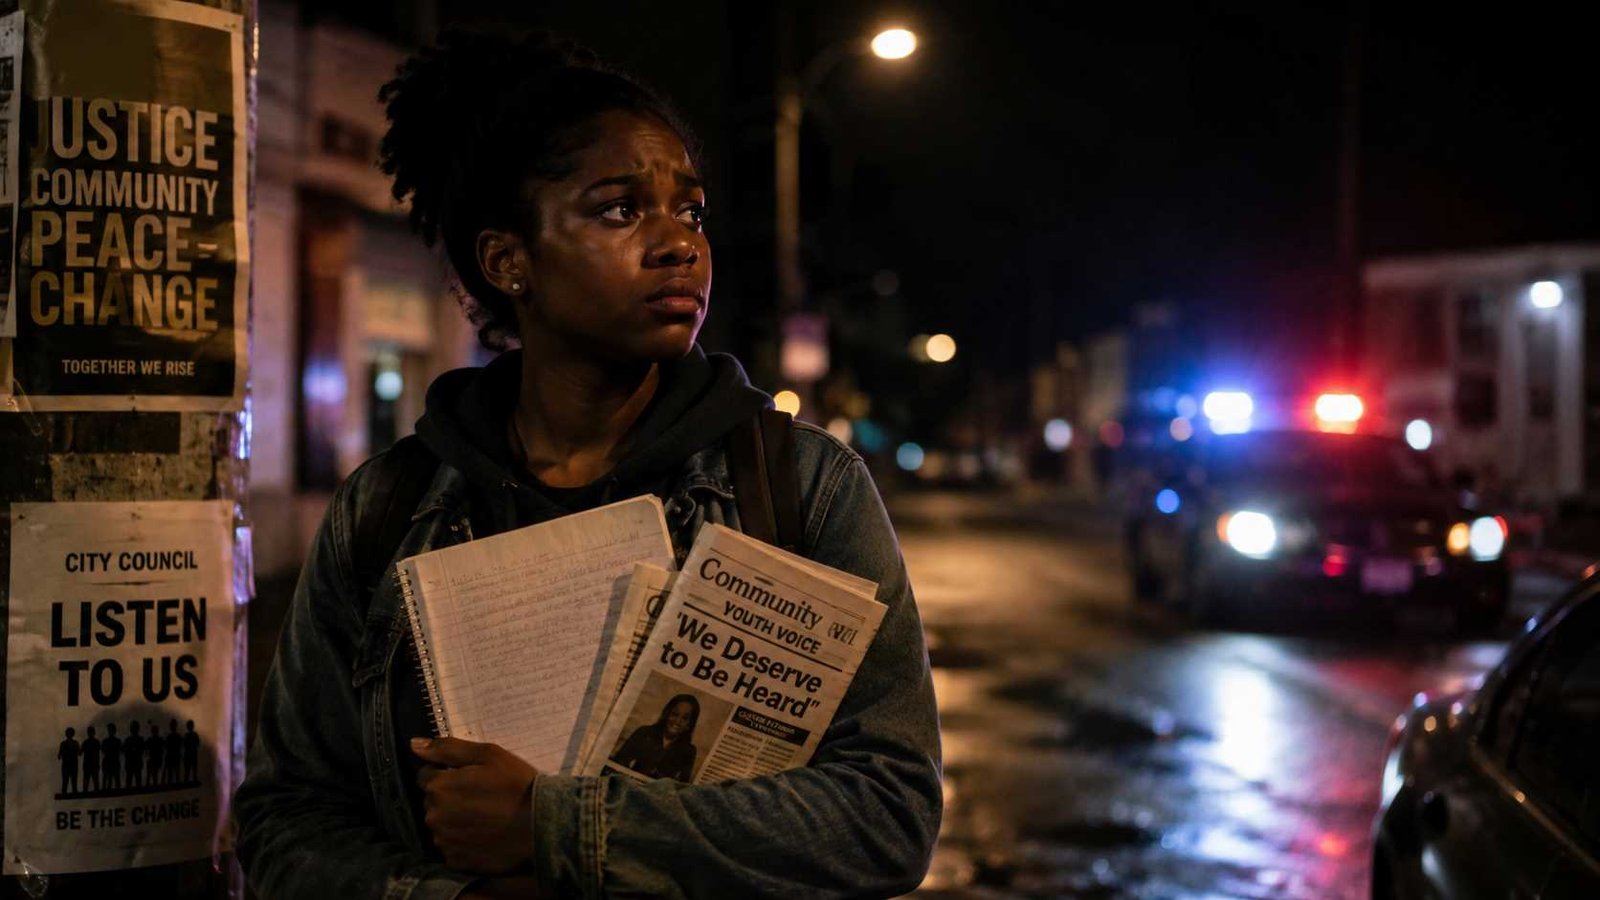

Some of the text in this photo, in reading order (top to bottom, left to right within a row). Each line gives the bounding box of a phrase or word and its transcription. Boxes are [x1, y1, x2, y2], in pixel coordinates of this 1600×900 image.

[31, 97, 218, 171] JUSTICE
[31, 168, 219, 216] COMMUNITY
[30, 271, 219, 331] CHANGE
[62, 359, 195, 377] TOGETHER WE RISE
[65, 551, 198, 573] CITY COUNCIL
[699, 557, 823, 629] Community
[51, 597, 207, 648] LISTEN
[722, 600, 775, 636] YOUTH
[776, 627, 822, 656] VOICE
[59, 654, 199, 707] TO US
[660, 641, 689, 671] to
[692, 656, 729, 689] Be
[722, 635, 822, 693] Deserve
[56, 802, 200, 830] BE THE CHANGE
